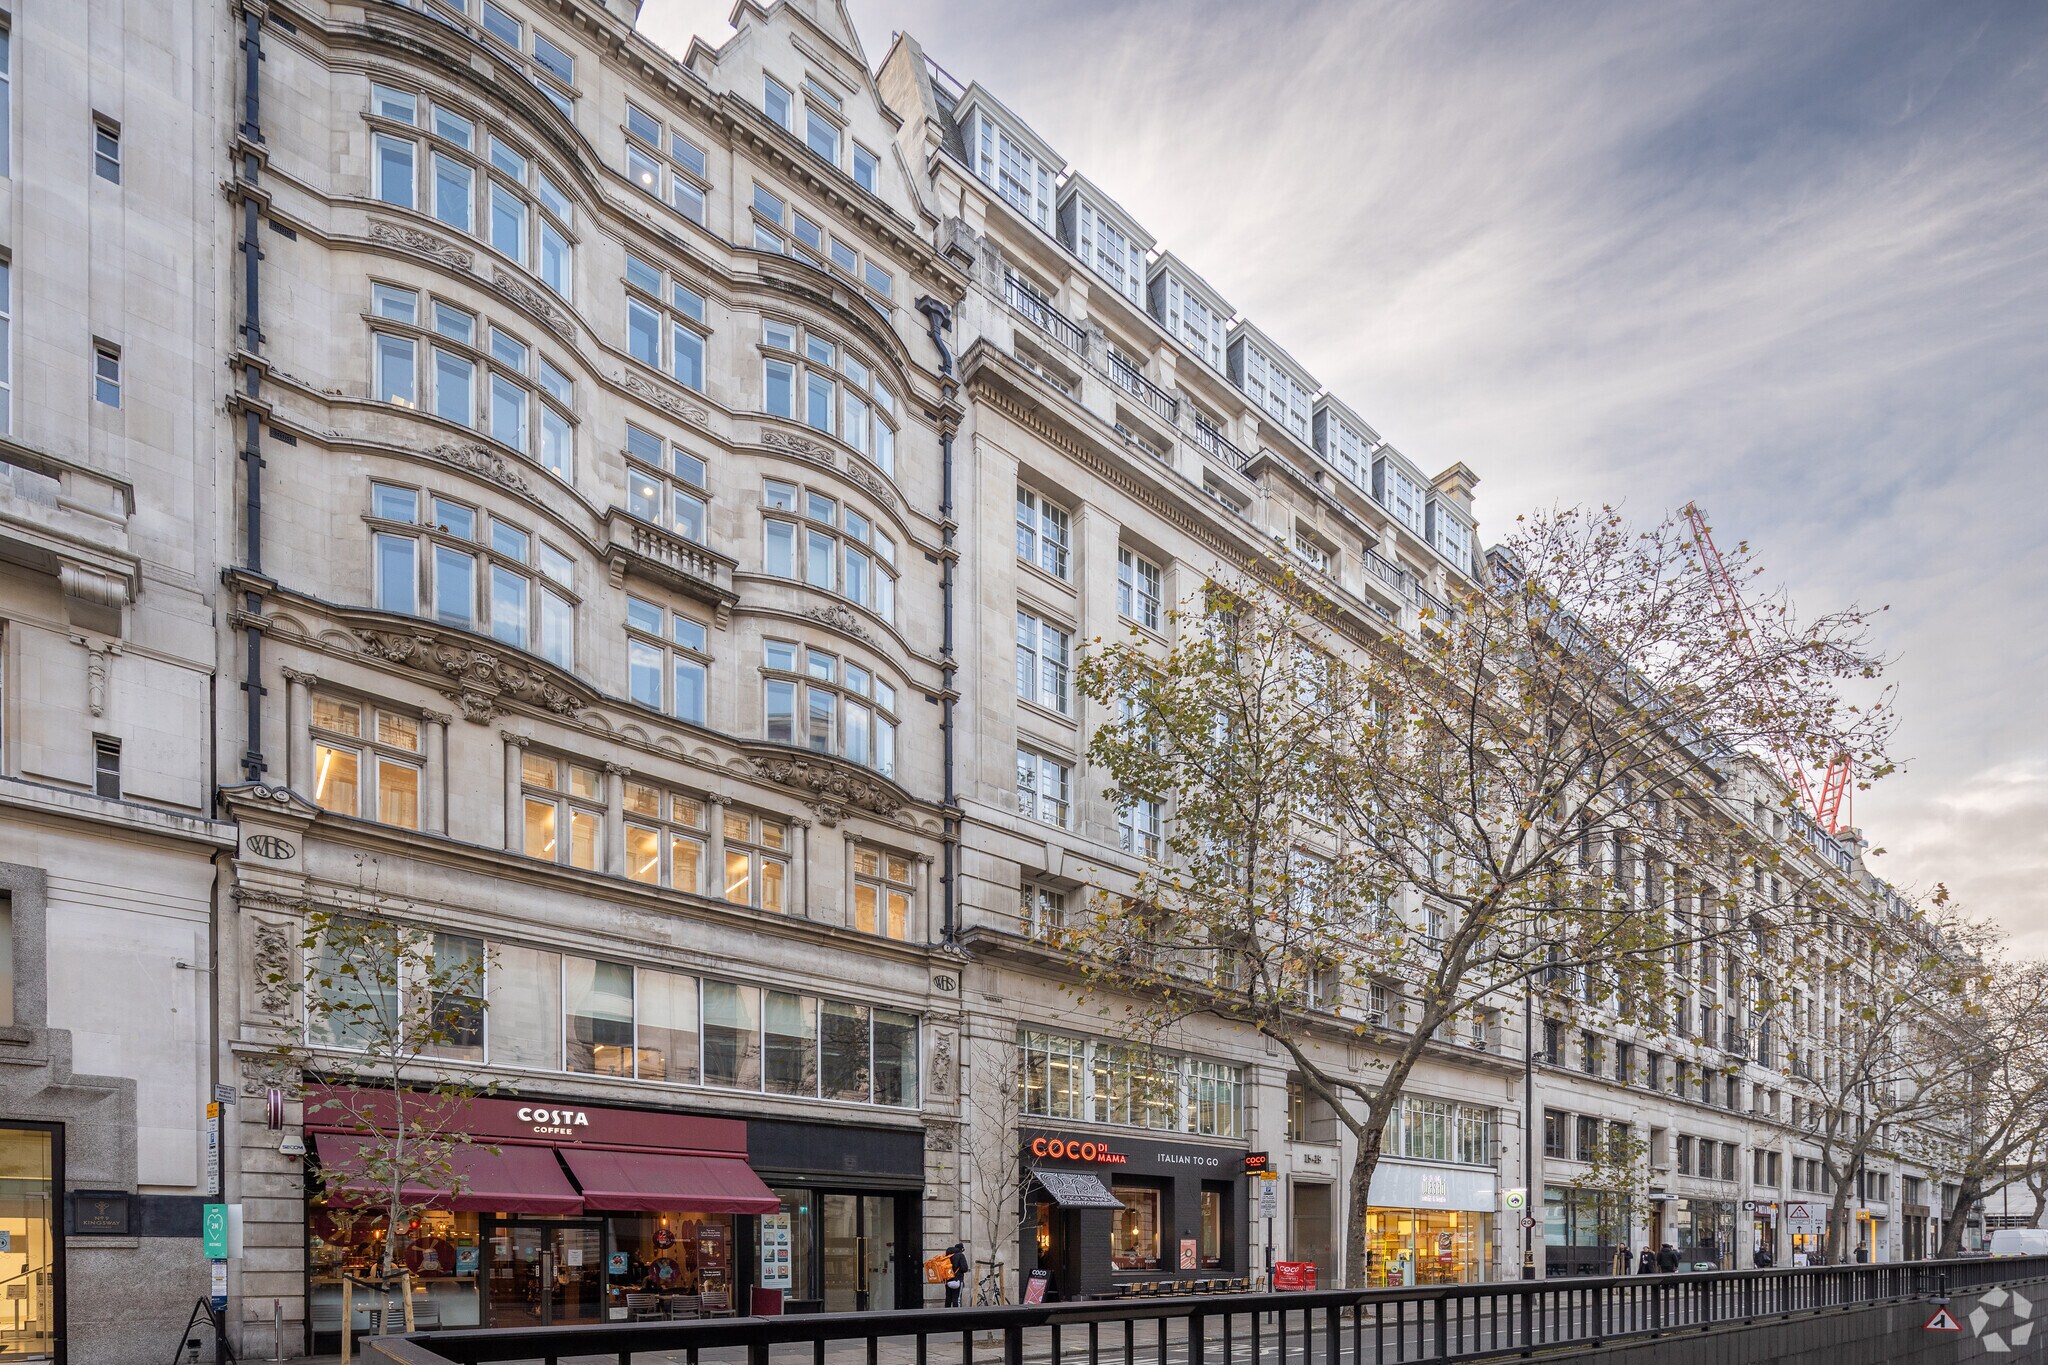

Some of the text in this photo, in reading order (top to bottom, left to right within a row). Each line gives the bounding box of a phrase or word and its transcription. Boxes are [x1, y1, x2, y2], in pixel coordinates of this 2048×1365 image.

[517, 1107, 589, 1126] COSTA
[533, 1126, 572, 1135] COFFEE
[1032, 1137, 1097, 1161] COCO
[1098, 1143, 1108, 1152] DI
[1097, 1153, 1127, 1164] MAMA
[1157, 1153, 1219, 1166] ITALIAN TO GO
[1245, 1156, 1266, 1164] COCO
[1280, 1265, 1299, 1273] COCO
